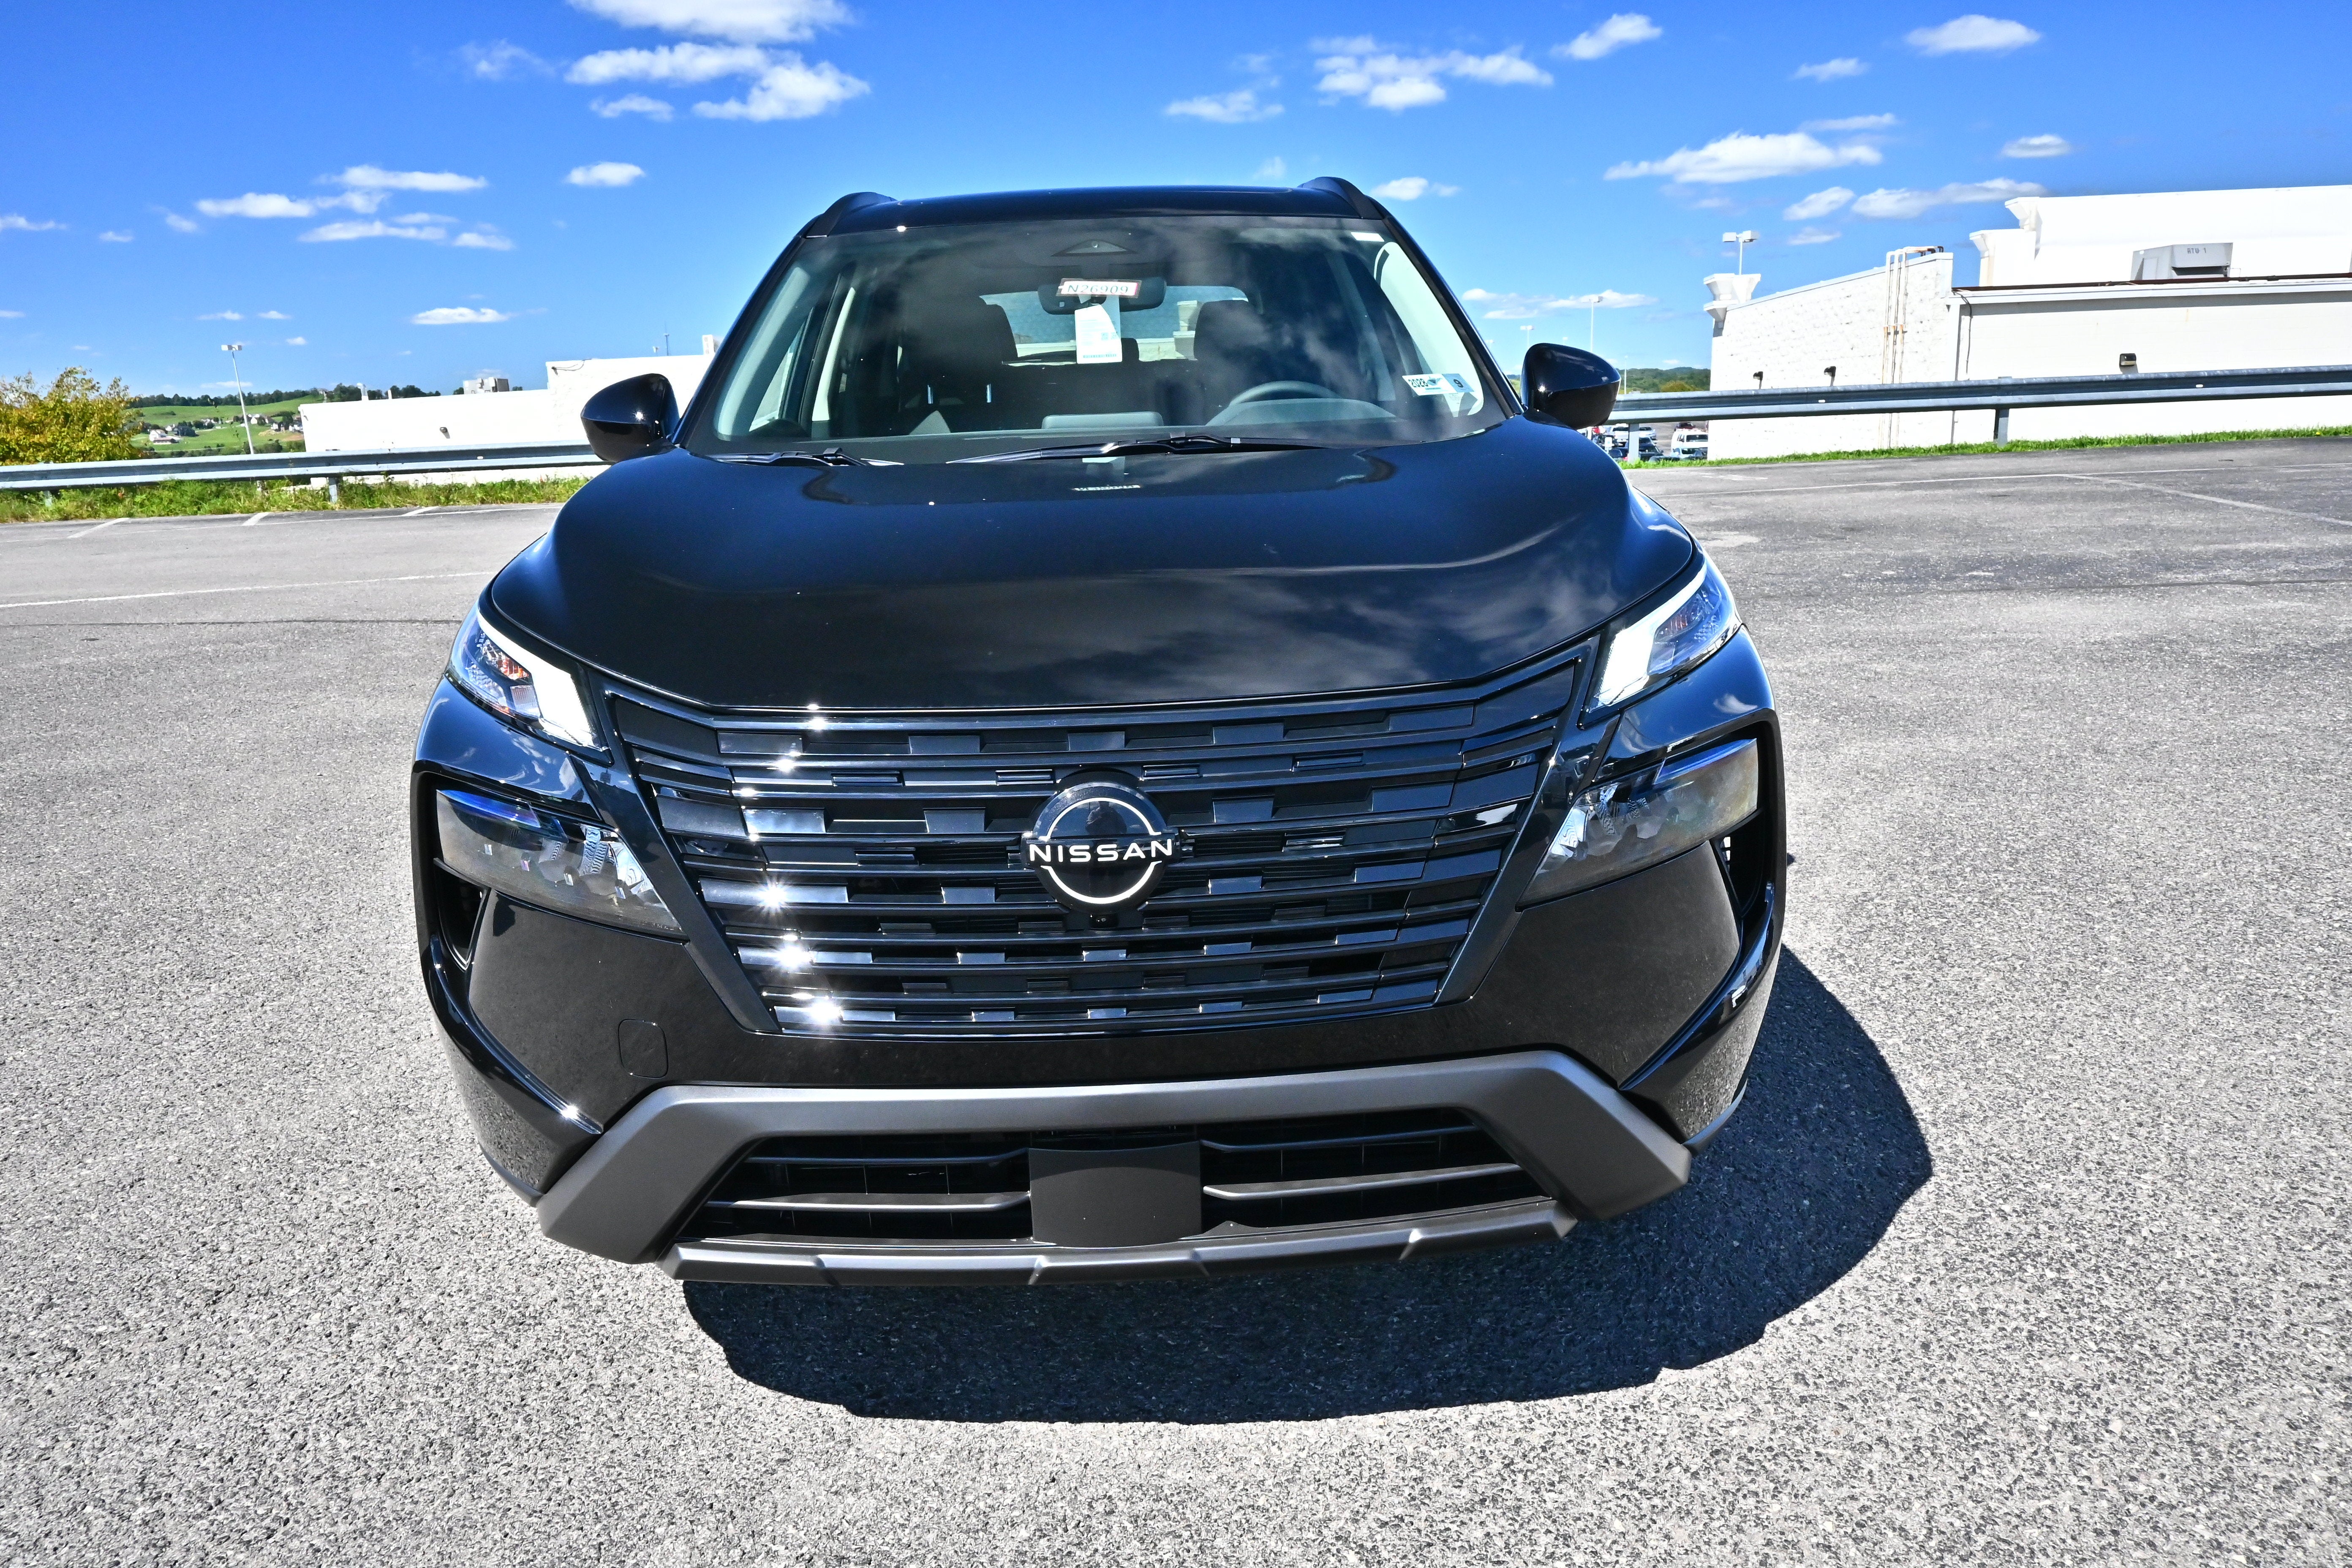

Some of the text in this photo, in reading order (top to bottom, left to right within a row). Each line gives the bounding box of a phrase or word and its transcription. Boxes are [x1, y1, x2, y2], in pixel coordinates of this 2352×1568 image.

[1067, 284, 1128, 295] N26909
[1408, 378, 1428, 387] 2028
[1454, 379, 1464, 388] 9
[1029, 838, 1173, 863] NISSAN
